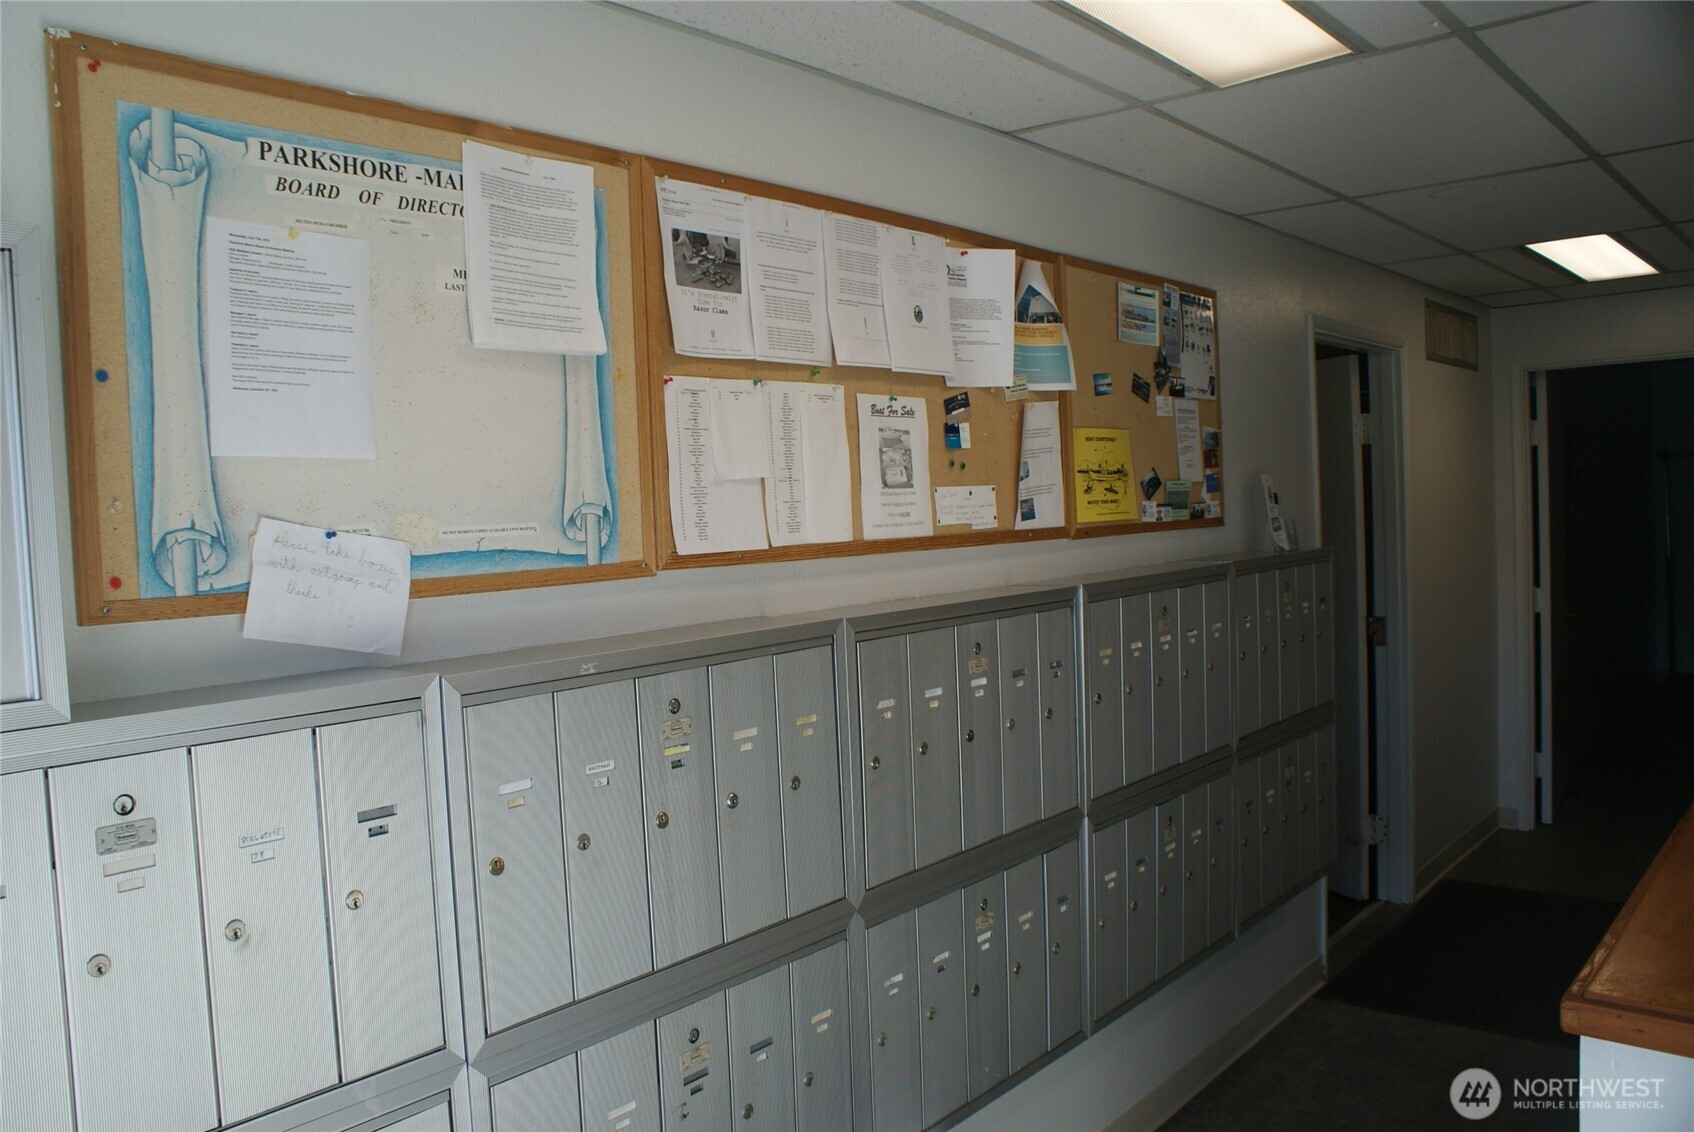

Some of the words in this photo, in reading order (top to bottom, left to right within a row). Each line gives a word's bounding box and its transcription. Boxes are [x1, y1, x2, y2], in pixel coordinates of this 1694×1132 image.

[258, 140, 408, 184] PARKSHORE
[275, 176, 341, 200] BOARD
[359, 189, 384, 206] OF
[445, 281, 465, 292] LAST
[693, 305, 710, 313] Razor
[711, 307, 729, 315] Clams
[870, 403, 886, 415] Boat
[886, 404, 899, 417] For
[900, 405, 916, 416] Sale
[320, 540, 352, 559] take
